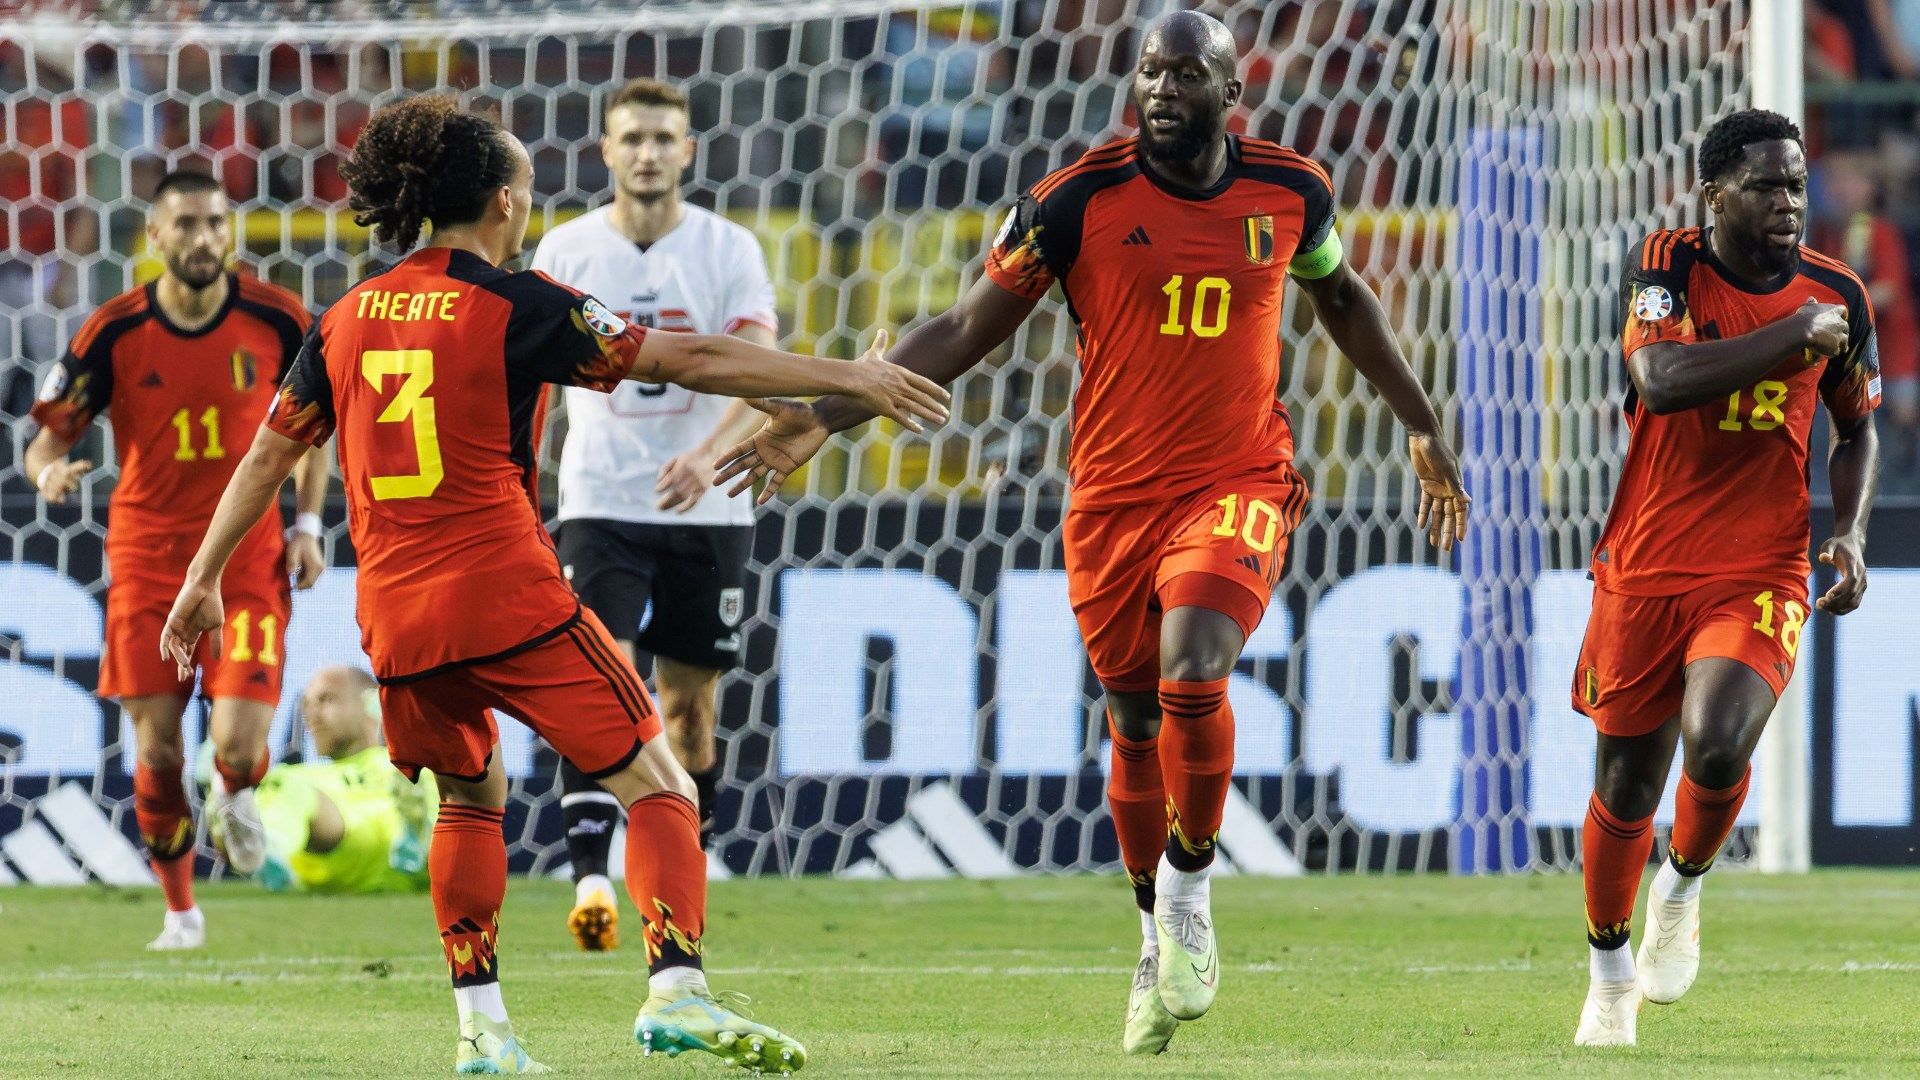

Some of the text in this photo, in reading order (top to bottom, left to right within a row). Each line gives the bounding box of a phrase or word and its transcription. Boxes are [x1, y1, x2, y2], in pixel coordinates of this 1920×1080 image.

[356, 290, 460, 322] THEATE
[1160, 274, 1232, 338] 10
[172, 406, 226, 461] 11
[361, 349, 444, 501] 3
[1718, 380, 1788, 431] 18
[1211, 493, 1279, 553] 10
[230, 608, 279, 667] 11
[1752, 590, 1804, 660] 18
